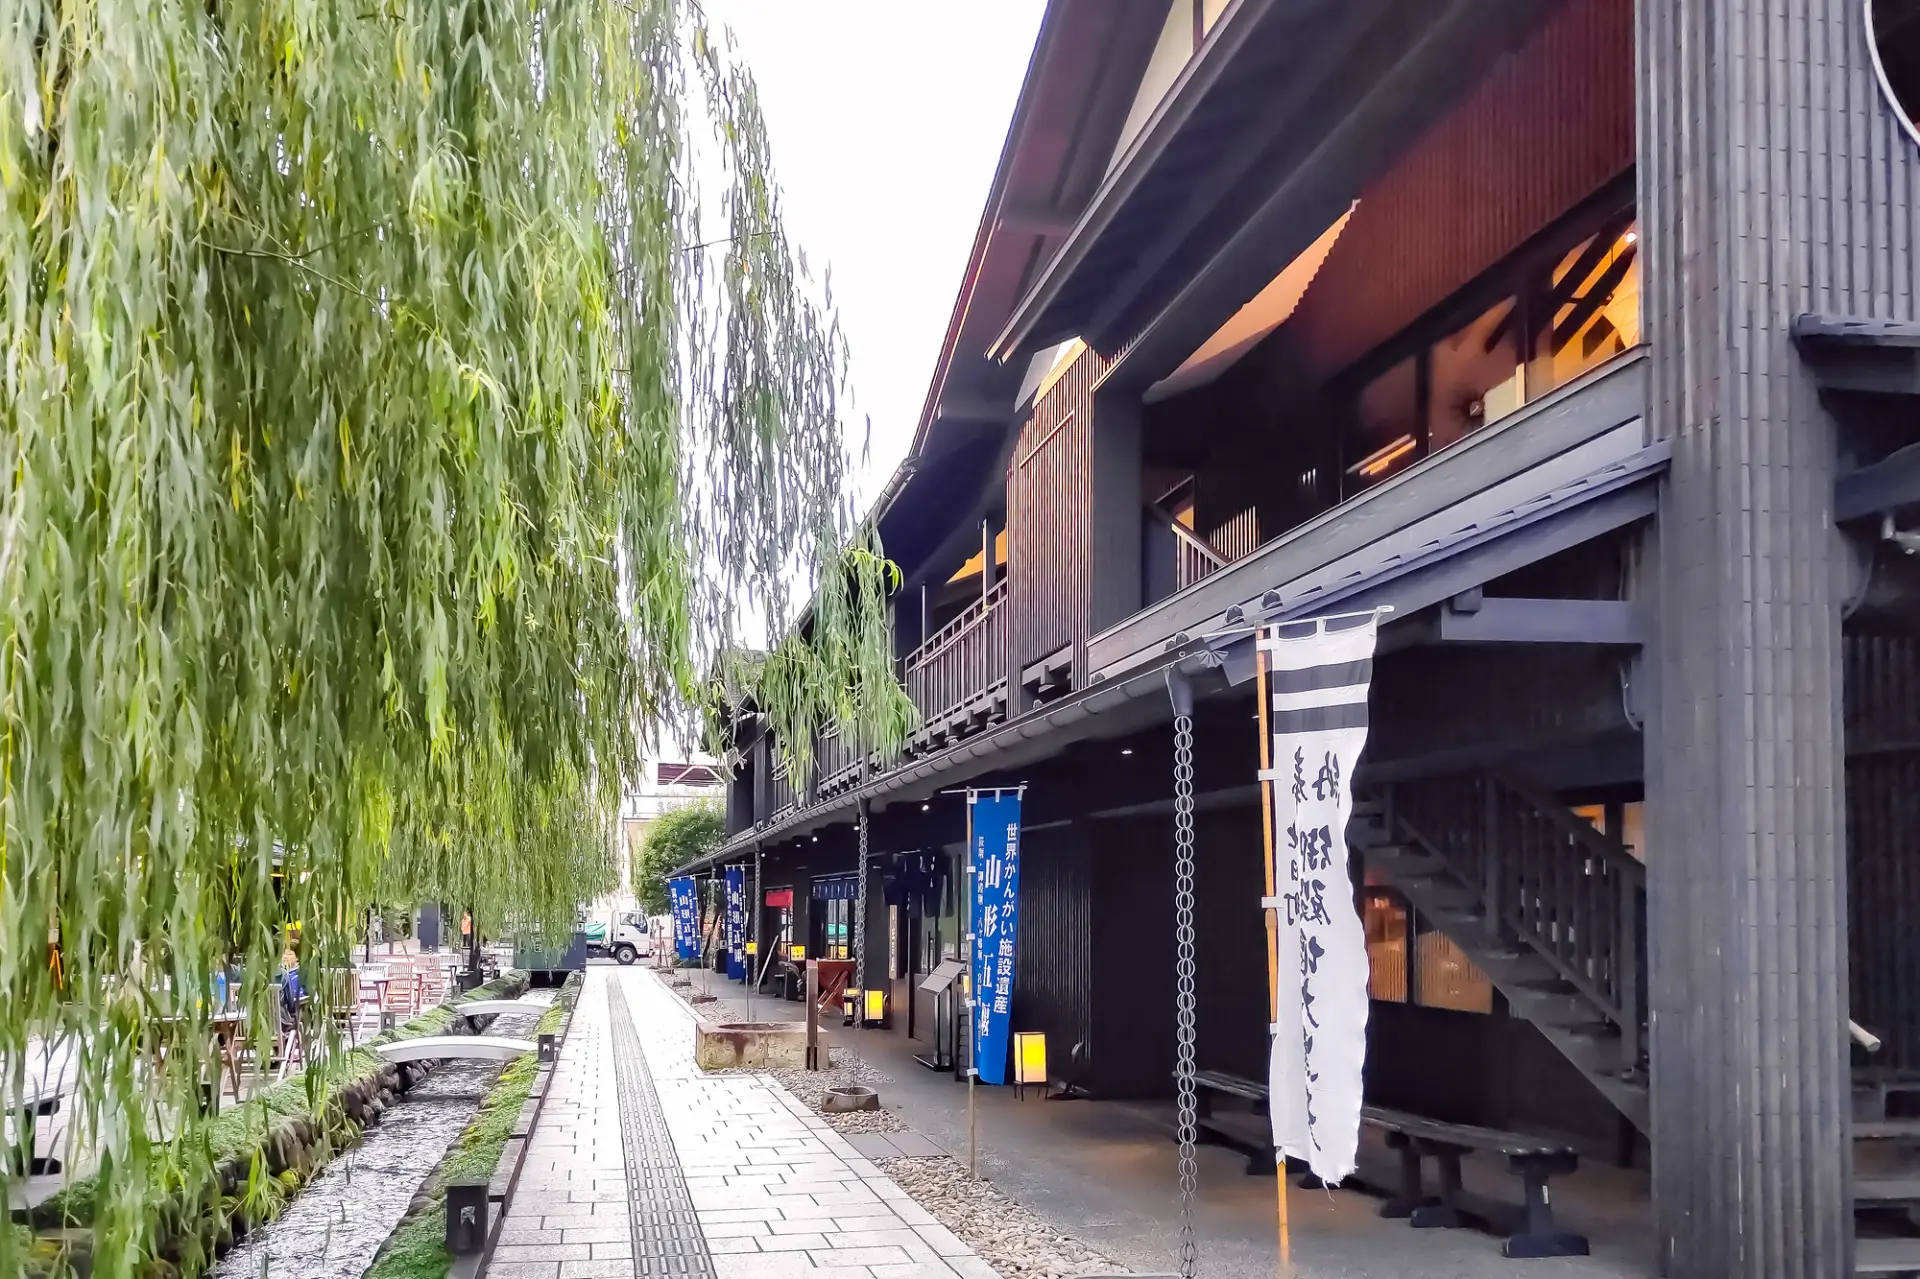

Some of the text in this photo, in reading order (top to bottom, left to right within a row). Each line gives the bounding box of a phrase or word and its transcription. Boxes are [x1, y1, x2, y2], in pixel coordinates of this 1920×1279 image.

[981, 854, 1002, 1036] 山形五堰
[993, 823, 1018, 1014] 世界かんがい施設遺産
